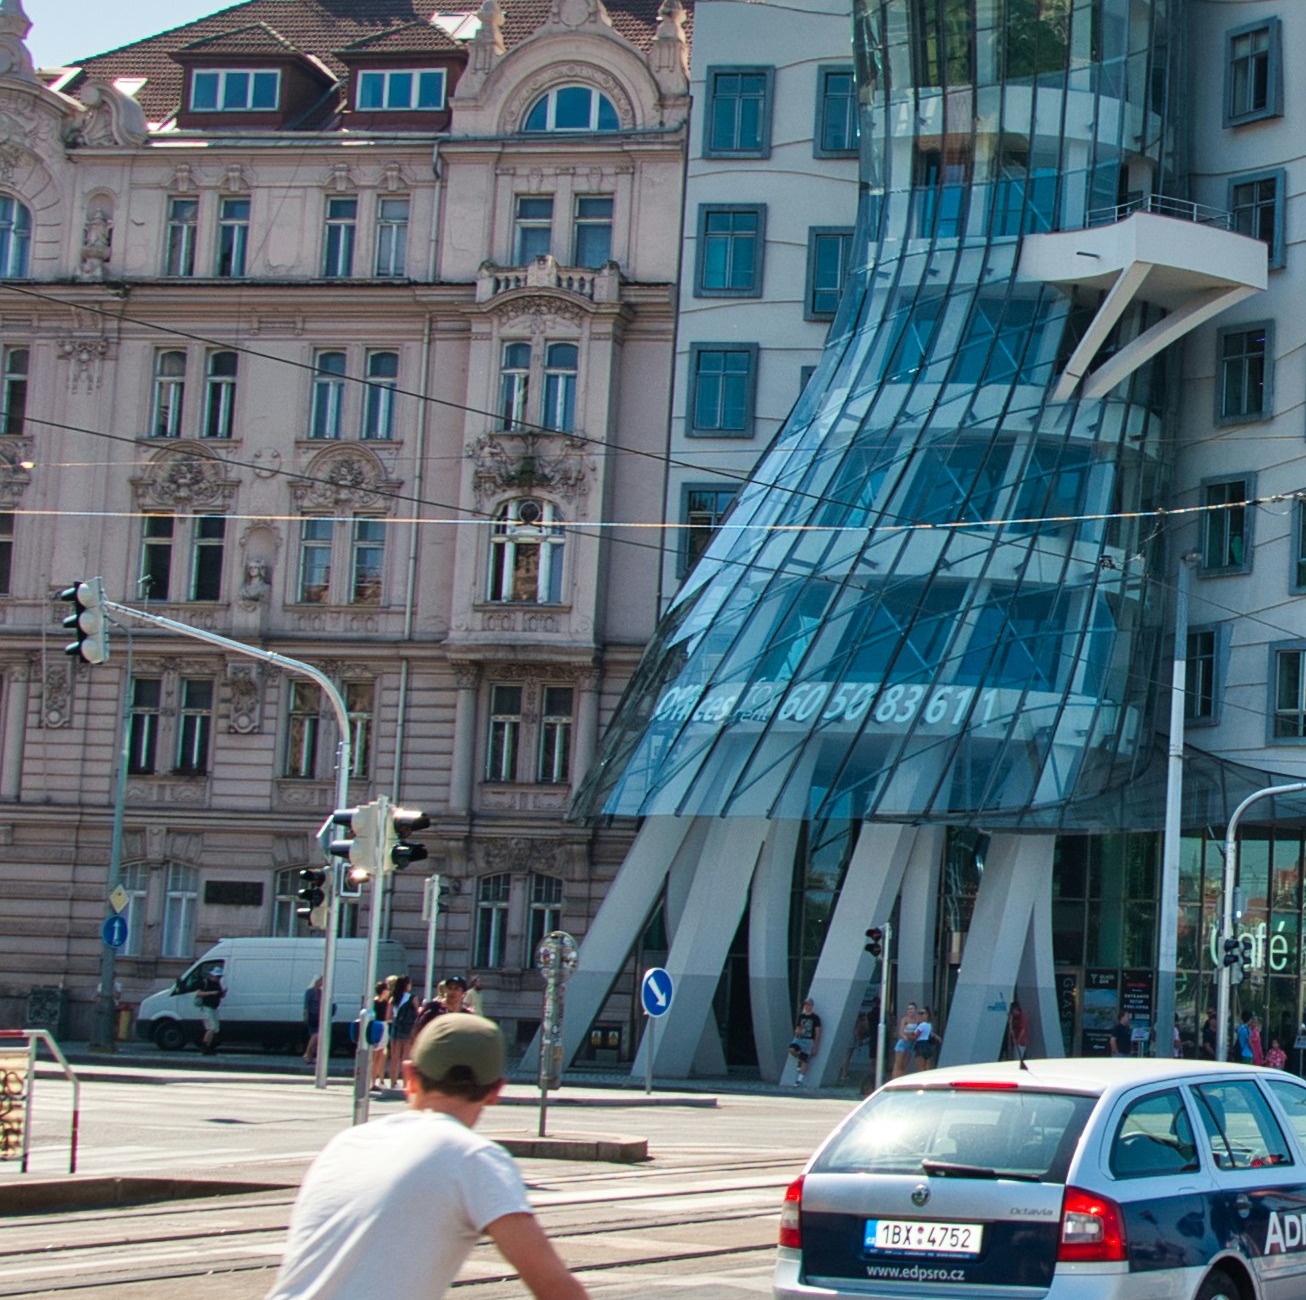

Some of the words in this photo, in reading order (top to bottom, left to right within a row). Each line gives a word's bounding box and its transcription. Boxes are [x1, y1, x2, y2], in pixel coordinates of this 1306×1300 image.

[1010, 1206, 1053, 1216] Octavia
[882, 1224, 912, 1246] 1BX
[926, 1226, 972, 1249] 4752
[866, 1265, 965, 1281] www.edpsro.cz
